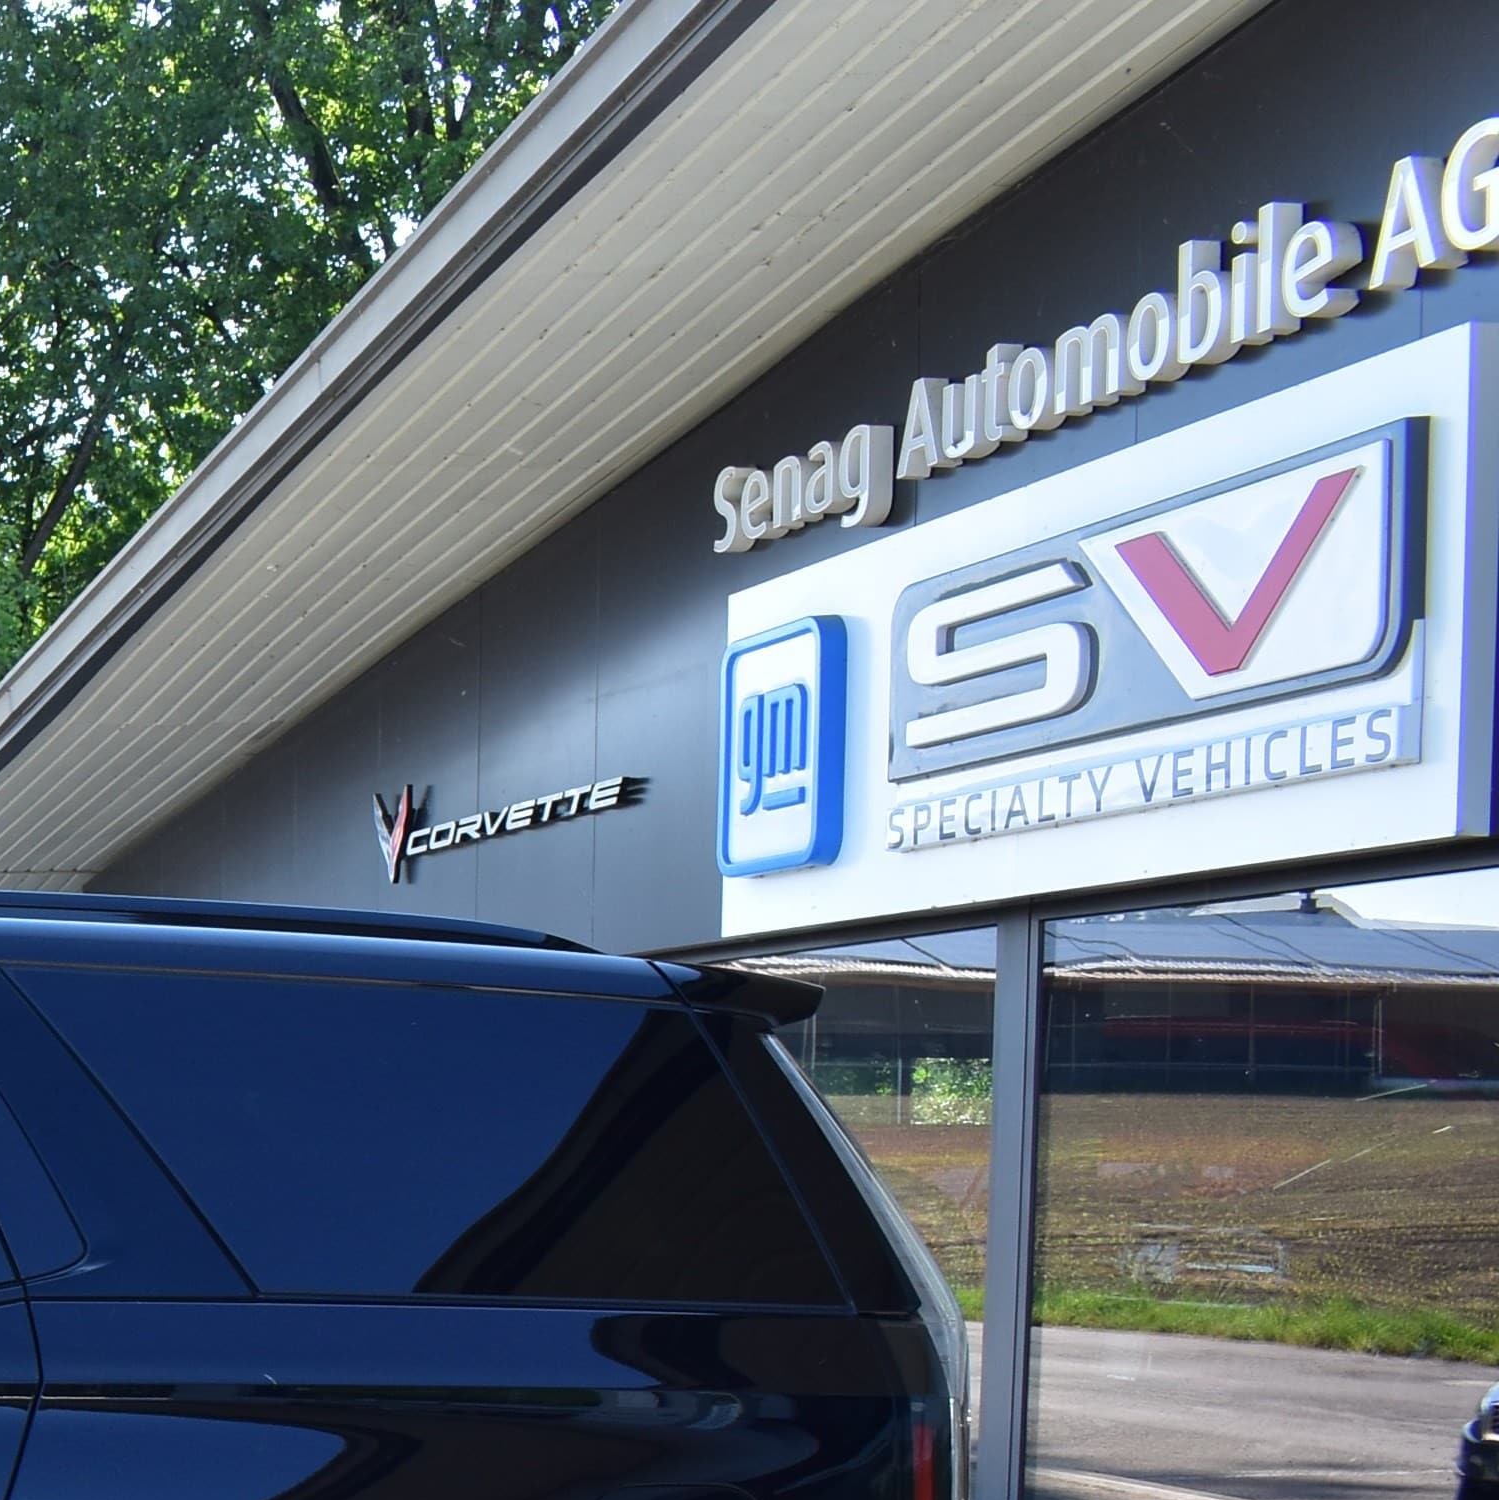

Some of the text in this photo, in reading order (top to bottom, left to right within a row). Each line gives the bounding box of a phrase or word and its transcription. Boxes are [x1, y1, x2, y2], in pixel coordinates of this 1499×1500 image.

[713, 114, 1499, 554] Senag Automobile AG
[903, 465, 1369, 750] SV
[405, 775, 625, 857] CORVETTE
[736, 682, 809, 817] gm
[886, 708, 1393, 850] SPECIALTY VEHICLES
